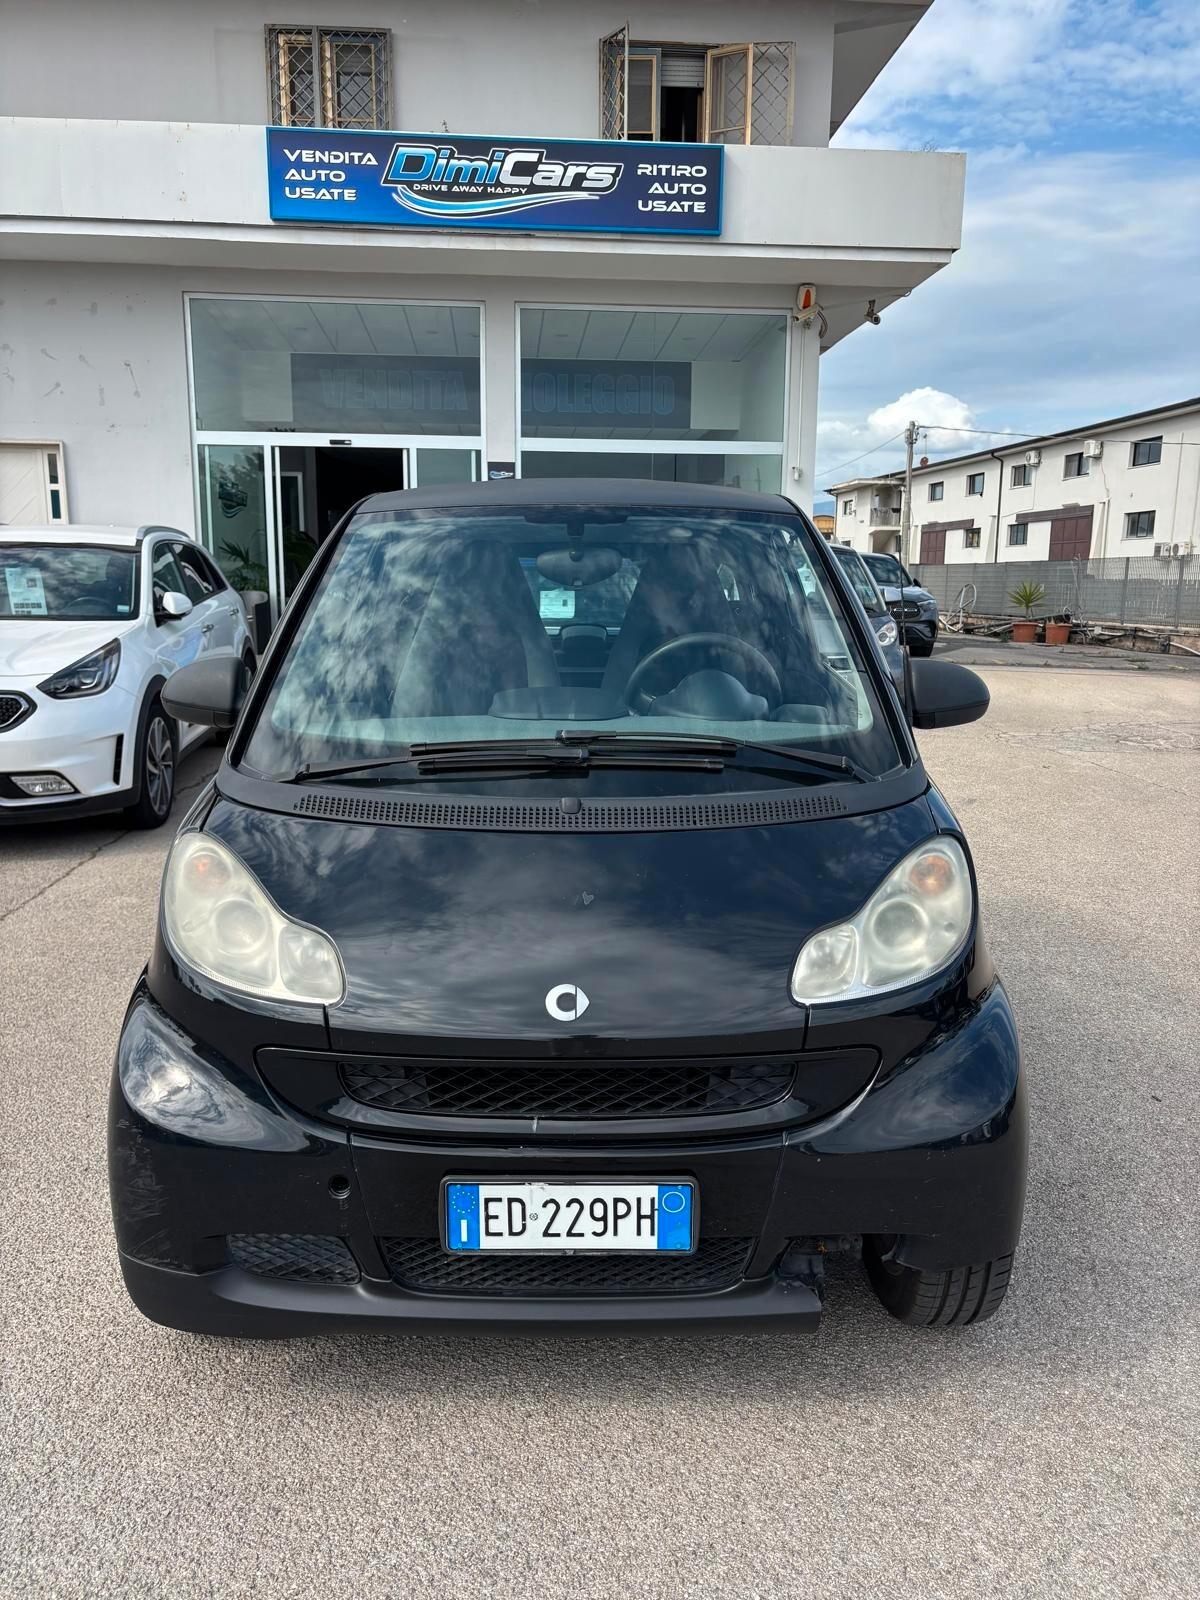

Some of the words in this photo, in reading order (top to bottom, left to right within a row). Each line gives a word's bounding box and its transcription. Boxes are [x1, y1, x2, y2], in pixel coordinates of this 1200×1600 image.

[283, 149, 378, 165] VENDITA
[387, 146, 617, 187] DimiCars
[637, 164, 707, 177] RITIRO
[284, 168, 346, 182] AUTO
[285, 187, 357, 200] USATE
[413, 183, 448, 192] DRIVE
[451, 185, 484, 193] AWAY
[487, 186, 528, 194] HAPPY
[648, 182, 707, 195] AUTO
[638, 200, 706, 213] USATE
[319, 368, 468, 410] VENDITA
[484, 1197, 527, 1237] ED
[541, 1197, 656, 1238] 229PH
